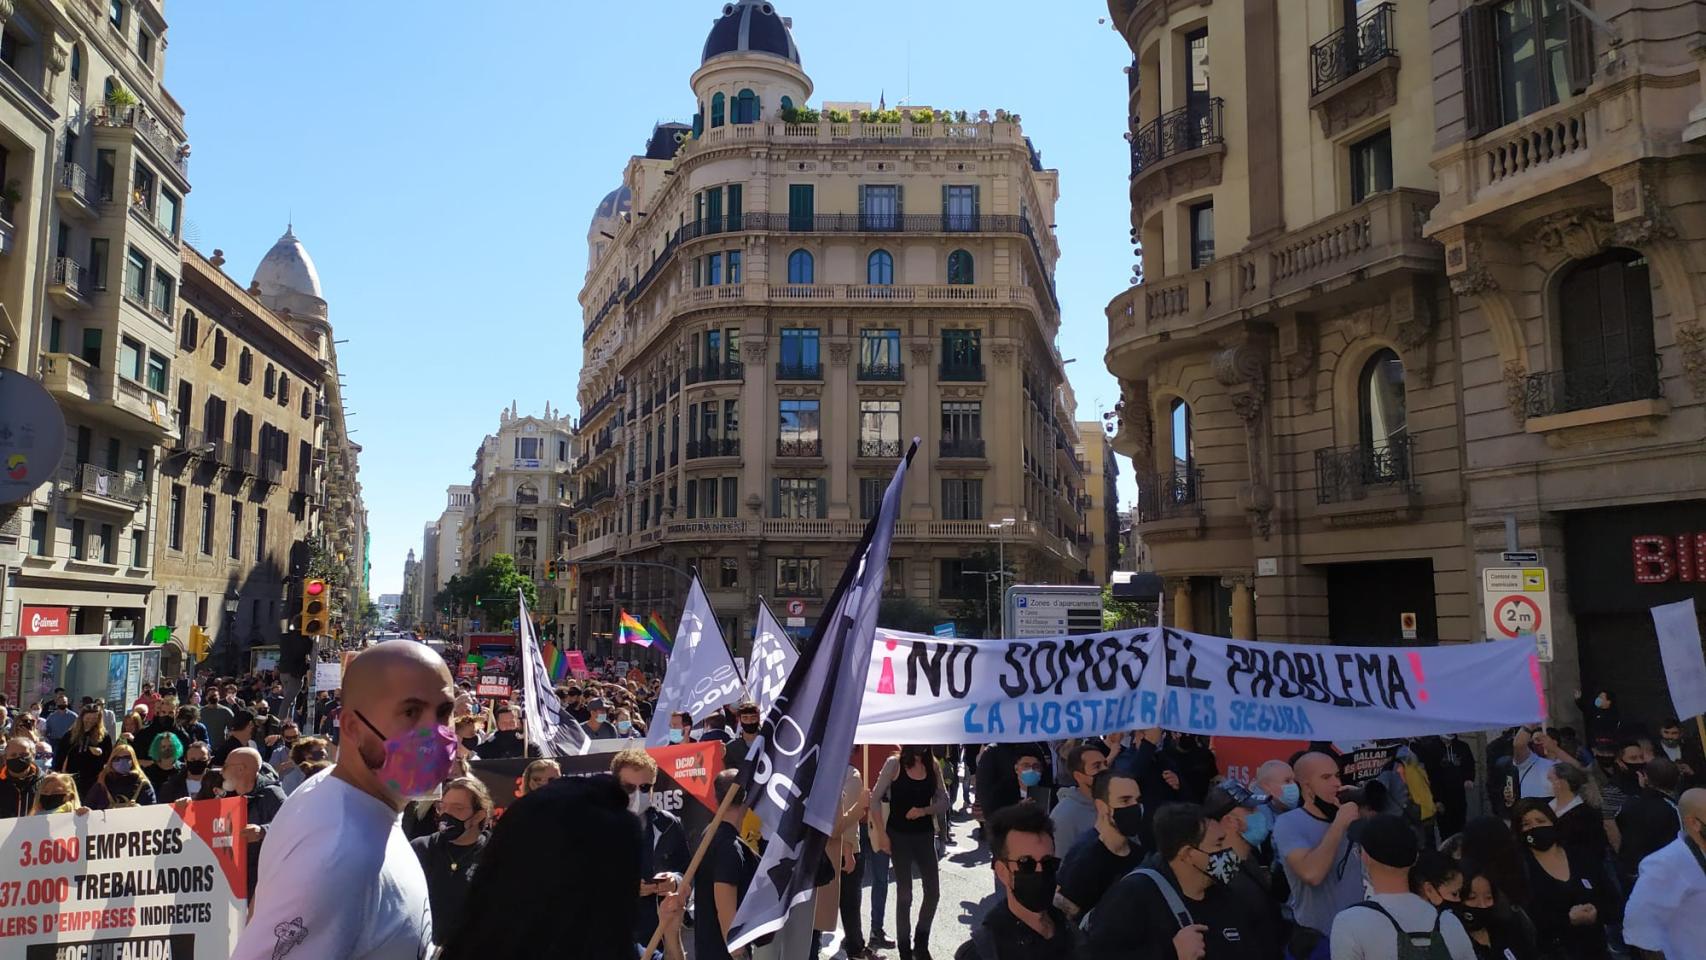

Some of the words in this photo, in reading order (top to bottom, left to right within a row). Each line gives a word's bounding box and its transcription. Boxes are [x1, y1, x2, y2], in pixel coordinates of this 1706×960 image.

[1632, 534, 1706, 583] BI
[1506, 609, 1517, 622] 2
[1519, 613, 1531, 622] m
[999, 631, 1151, 698] SOMOS
[1162, 628, 1212, 690] EL
[1226, 643, 1429, 710] PROBLEMA!
[964, 702, 1005, 735] LA
[1189, 694, 1217, 731] ES
[1229, 699, 1315, 735] SEGURA
[19, 837, 80, 867] 3.600
[86, 828, 183, 860] EMPRESES
[74, 865, 214, 901] TREBALLADORS
[43, 907, 137, 934] D'EMPRESES
[140, 903, 212, 926] INDIRECTES
